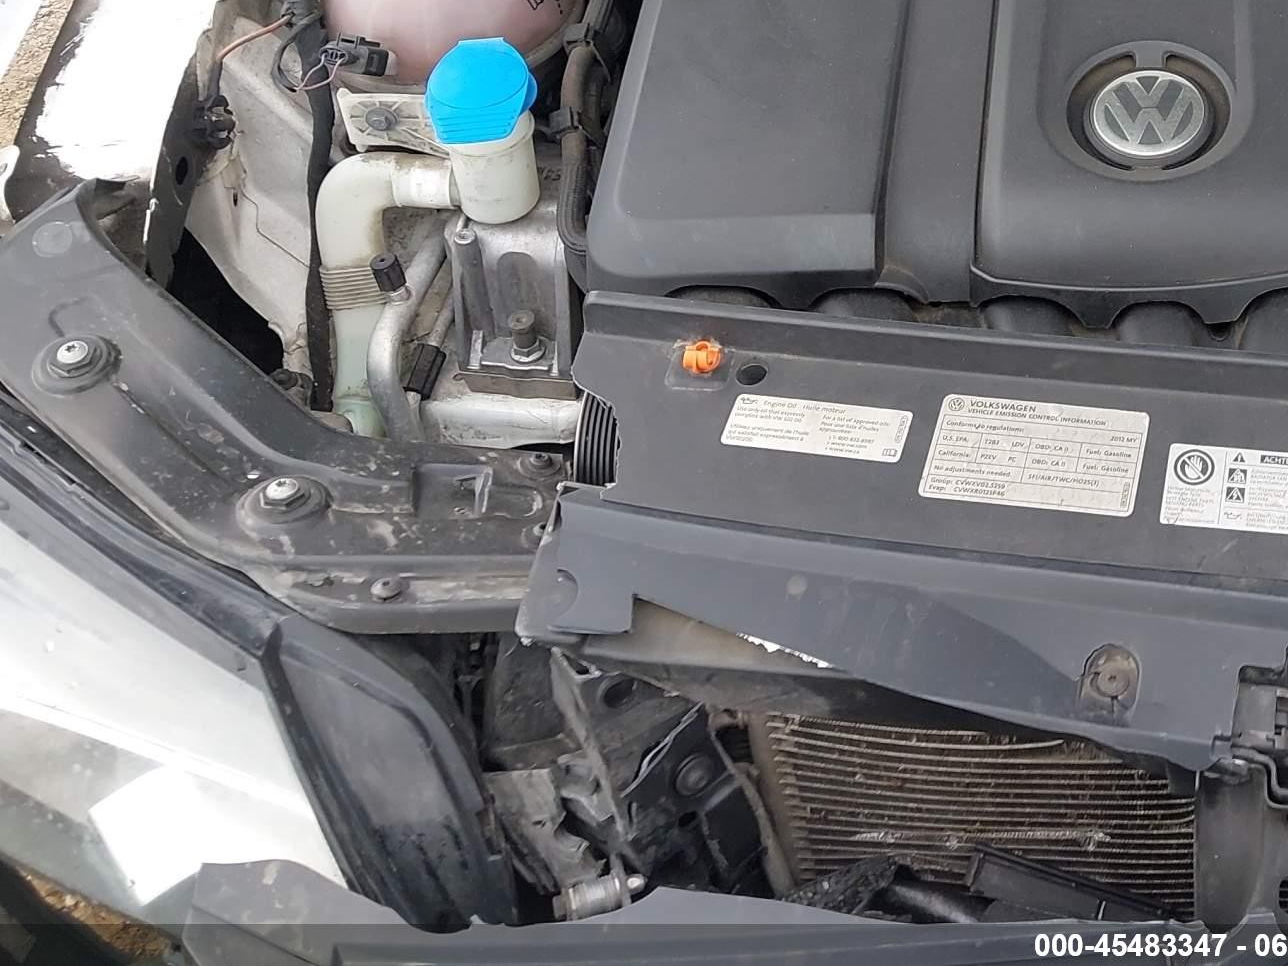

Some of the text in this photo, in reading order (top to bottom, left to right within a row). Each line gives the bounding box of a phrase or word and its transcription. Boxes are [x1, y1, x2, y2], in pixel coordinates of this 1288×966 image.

[970, 400, 1036, 412] VOLKSWAGEN
[1028, 414, 1059, 422] CONTROL
[1060, 417, 1107, 426] INFORMATION
[1104, 450, 1132, 458] Gasoline
[1101, 465, 1129, 474] Gasoline
